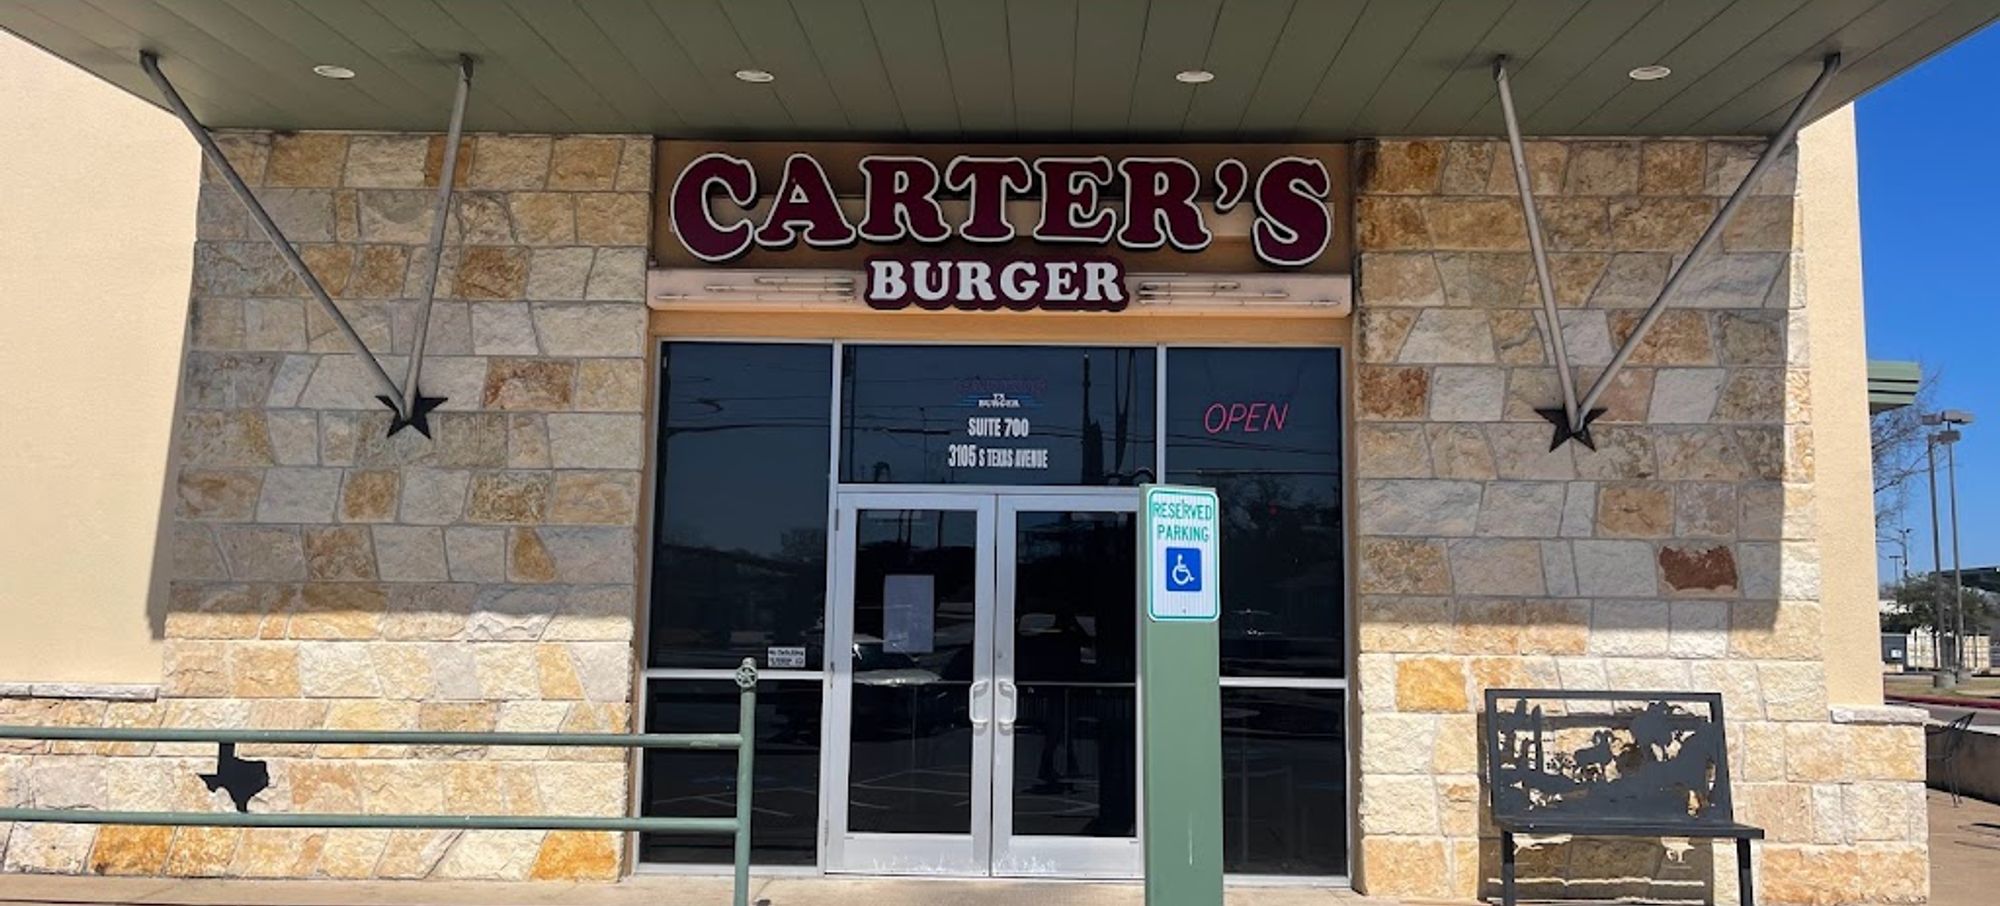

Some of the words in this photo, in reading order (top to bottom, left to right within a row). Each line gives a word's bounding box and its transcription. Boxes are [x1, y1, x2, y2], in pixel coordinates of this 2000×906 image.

[669, 152, 1332, 266] CARTER'S
[869, 260, 1125, 304] BURGER
[968, 418, 1001, 437] SUITE
[1004, 418, 1029, 437] 700
[1204, 403, 1289, 433] OPEN
[948, 444, 977, 467] 3105
[978, 448, 985, 467] S
[986, 448, 1013, 467] TEXAS
[1015, 449, 1048, 468] AVENUE
[1152, 502, 1212, 520] RESERVED
[1157, 524, 1209, 542] PARKING
